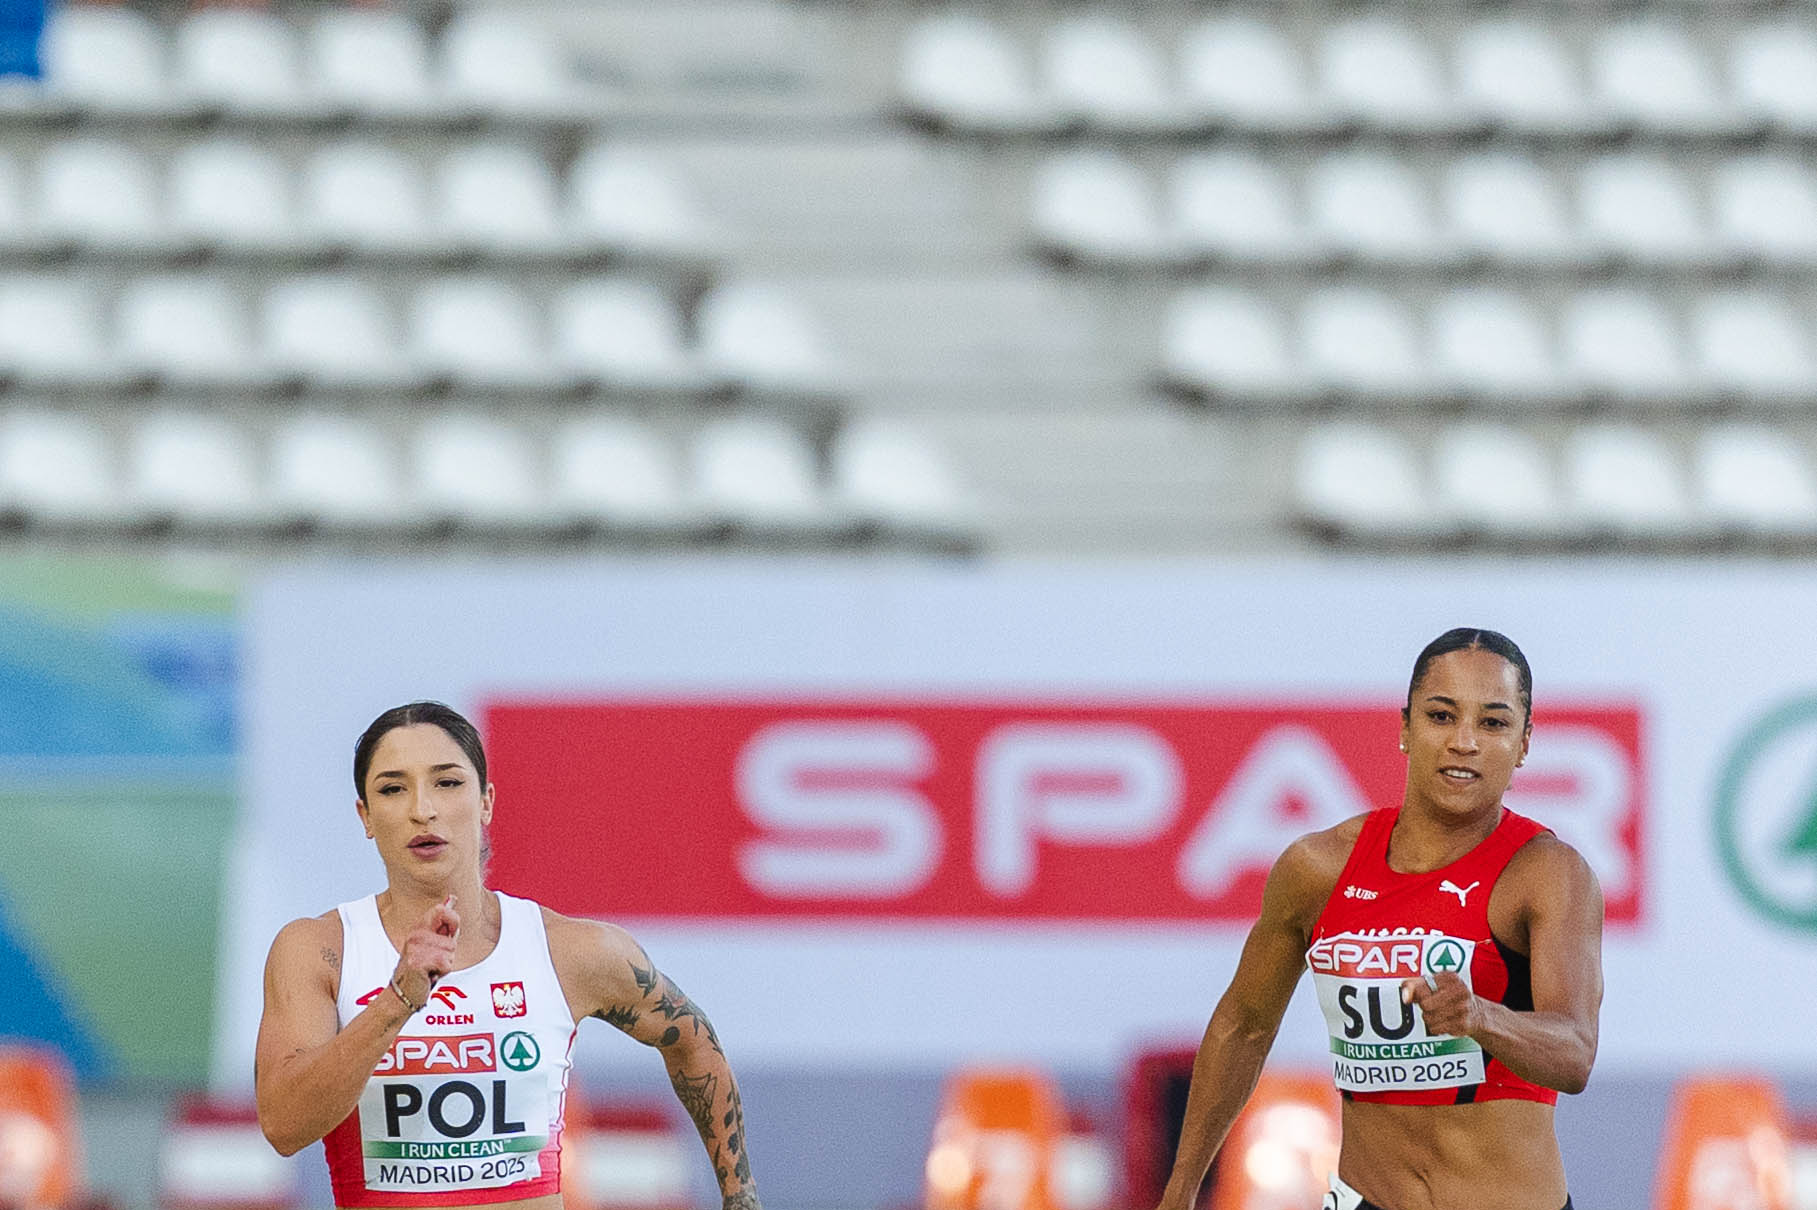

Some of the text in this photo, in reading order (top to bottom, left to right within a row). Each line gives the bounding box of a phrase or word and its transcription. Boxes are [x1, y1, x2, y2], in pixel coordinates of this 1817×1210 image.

[734, 718, 1632, 900] SPAR
[1355, 887, 1378, 900] UBS
[1311, 942, 1420, 974] SPAR
[425, 1014, 475, 1026] ORLEN
[1338, 984, 1440, 1041] SU
[1334, 1059, 1468, 1085] MADRID 2025
[383, 1079, 526, 1139] POL
[409, 1143, 445, 1158] RUN
[379, 1154, 528, 1185] MADRID 2025
